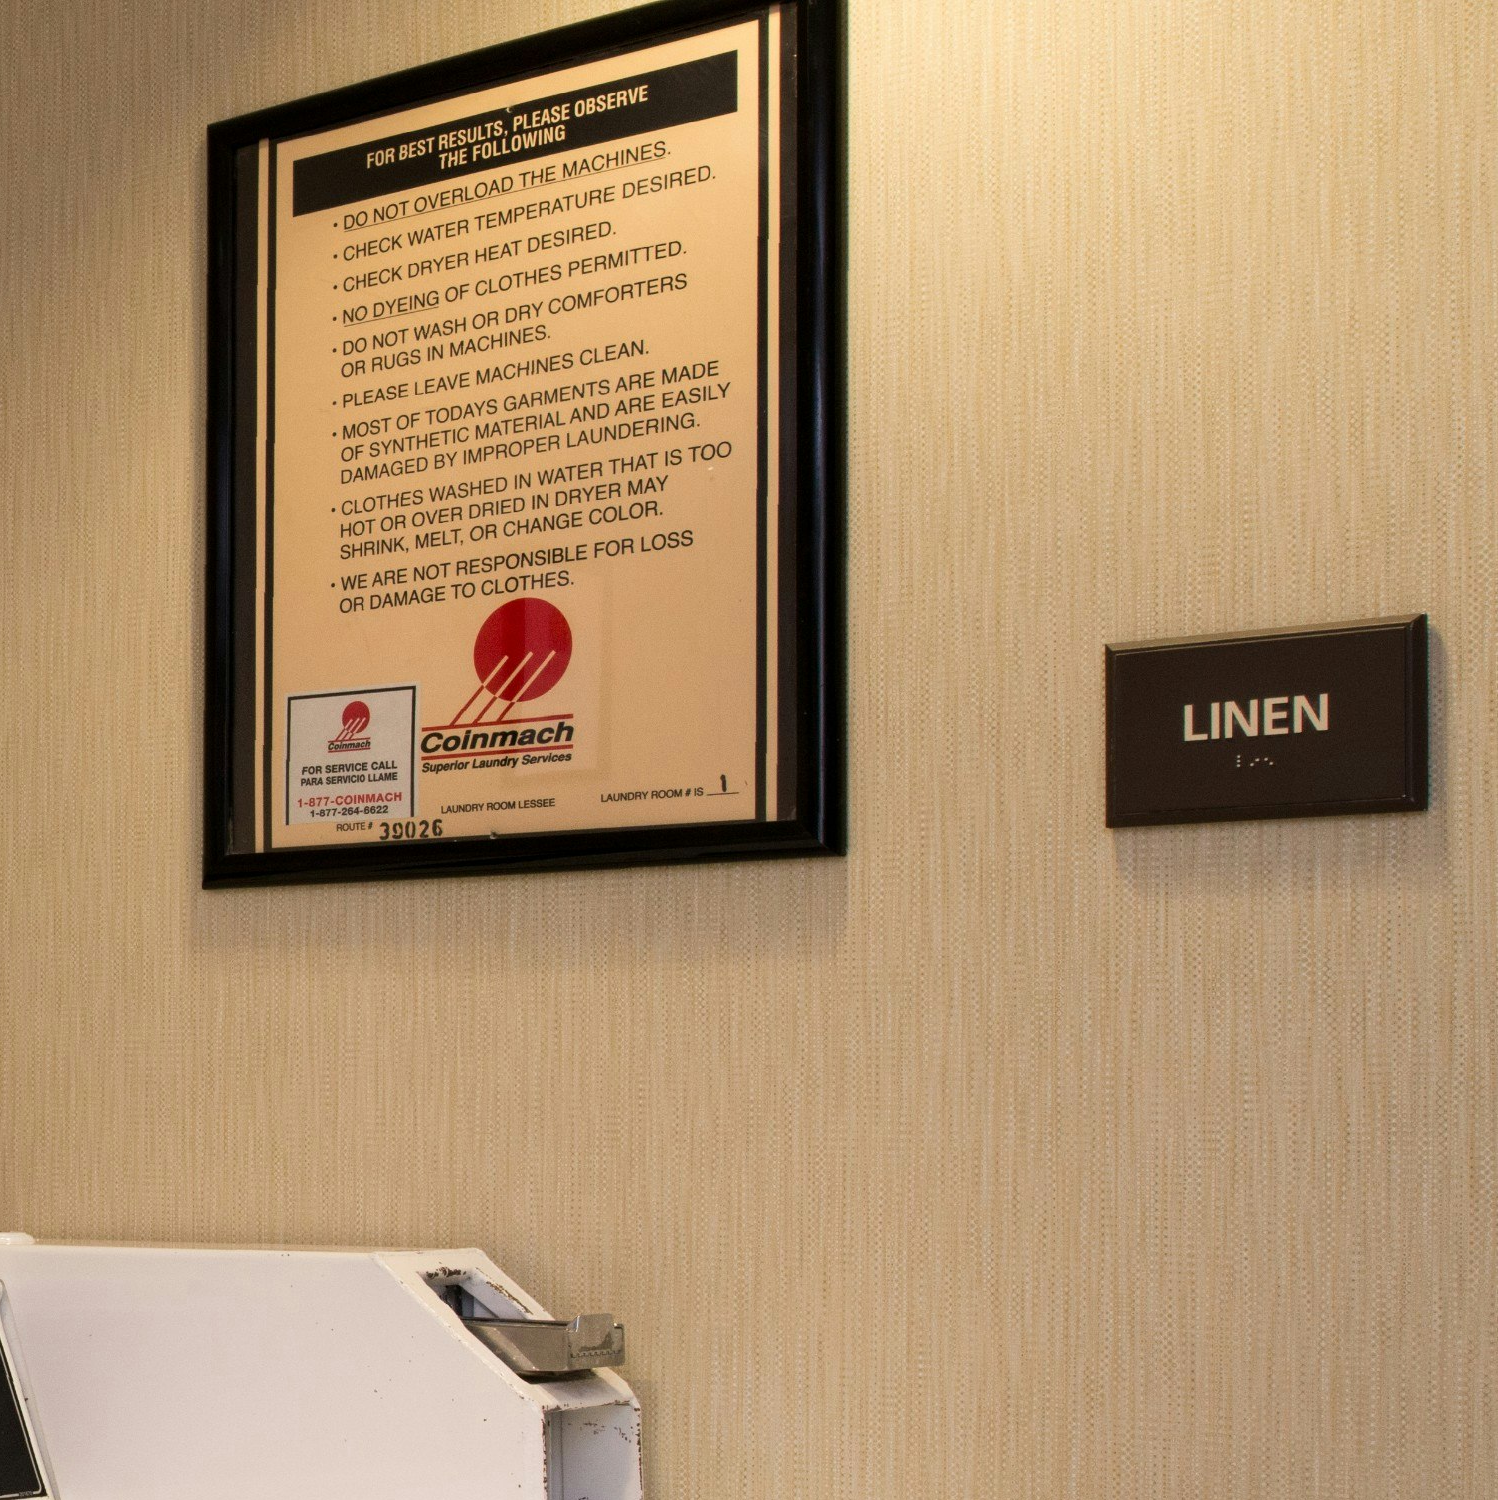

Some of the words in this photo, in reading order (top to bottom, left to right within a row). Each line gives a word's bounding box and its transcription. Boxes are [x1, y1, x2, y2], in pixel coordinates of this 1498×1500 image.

[367, 147, 395, 169] FOR
[398, 136, 435, 161] BEST
[438, 120, 508, 151] RESULTS,
[513, 103, 571, 132] PLEASE
[574, 85, 649, 118] OBSERVE
[438, 147, 468, 170] THE
[472, 125, 566, 162] FOLLOWING
[343, 211, 369, 231] DO
[373, 200, 410, 223] NOT
[413, 175, 514, 213] OVERLOAD
[519, 166, 556, 188] THE
[561, 141, 671, 179] MACHINES.
[342, 233, 403, 262] CHECK
[407, 219, 469, 247] WATER
[473, 185, 616, 231] TEMPERATURE
[622, 165, 716, 199] DESIRED.
[342, 265, 403, 293] CHECK
[407, 251, 469, 279] DRYER
[475, 239, 522, 264] HEAT
[527, 221, 616, 254] DESIRED.
[342, 305, 368, 325] NO
[372, 290, 439, 318] DYEING
[444, 283, 470, 303] OF
[475, 264, 562, 297] CLOTHES
[568, 241, 687, 278] PERMITTED.
[342, 337, 368, 356] DO
[372, 328, 409, 350] NOT
[413, 316, 467, 341] WASH
[472, 310, 499, 330] OR
[505, 301, 544, 324] DRY
[548, 273, 688, 315] COMFORTERS
[341, 359, 366, 378] OR
[371, 348, 422, 373] RUGS
[427, 344, 444, 362] IN
[449, 324, 551, 358] MACHINES.
[342, 383, 409, 409] PLEASE
[414, 371, 470, 396] LEAVE
[476, 352, 574, 386] MACHINES
[579, 340, 649, 366] CLEAN.
[340, 444, 365, 463] OF
[369, 426, 470, 458] SYNTHETIC
[475, 410, 566, 440] MATERIAL
[569, 402, 610, 424] AND
[614, 394, 656, 417] ARE
[662, 381, 731, 409] EASILY
[342, 417, 392, 440] MOST
[396, 411, 421, 431] OF
[424, 398, 498, 425] TODAYS
[503, 379, 611, 412] GARMENTS
[614, 371, 655, 394] ARE
[661, 361, 719, 385] MADE
[341, 456, 429, 485] DAMAGED
[434, 451, 458, 470] BY
[463, 434, 560, 465] IMPROPER
[566, 413, 700, 449] LAUNDERING.
[341, 489, 424, 516] CLOTHES
[428, 476, 508, 503] WASHED
[514, 472, 531, 490] IN
[537, 461, 603, 486] WATER
[608, 452, 659, 475] THAT
[664, 448, 683, 467] IS
[687, 441, 732, 463] TOO
[340, 518, 376, 539] HOT
[380, 514, 407, 532] OR
[411, 506, 463, 528] OVER
[468, 497, 526, 520] DRIED
[532, 493, 549, 511] IN
[555, 482, 621, 507] DRYER
[627, 475, 669, 497] MAY
[340, 536, 409, 560] SHRINK,
[415, 528, 464, 550] MELT,
[469, 523, 497, 542] OR
[503, 510, 583, 537] CHANGE
[588, 500, 663, 525] COLOR.
[340, 573, 368, 591] WE
[371, 567, 408, 588] ARE
[413, 562, 452, 582] NOT
[456, 544, 588, 577] RESPONSIBLE
[594, 538, 635, 559] FOR
[640, 529, 694, 553] LOSS
[339, 596, 364, 614] OR
[369, 585, 446, 610] DAMAGE
[450, 582, 476, 600] TO
[480, 570, 574, 596] CLOTHES.
[420, 721, 574, 754] Coinmach
[1184, 693, 1329, 742] LINEN
[301, 765, 323, 776] FOR
[325, 761, 368, 774] SERVICE
[370, 760, 398, 771] CALL
[327, 740, 371, 751] Coinmach
[421, 759, 471, 774] Superior
[472, 755, 520, 769] Laundry
[521, 752, 572, 766] Services
[297, 791, 402, 808] 1-877-COINMACH
[300, 776, 324, 787] PARA
[325, 773, 366, 786] SERVICIO
[367, 771, 398, 783] LLAME
[441, 802, 485, 815] LAUNDRY
[486, 800, 516, 811] ROOM
[518, 797, 556, 809] LESSEE
[600, 790, 649, 803] LAUNDRY
[651, 788, 683, 800] ROOM
[685, 788, 692, 797] #
[694, 786, 704, 797] IS
[719, 774, 727, 793] 1
[310, 804, 389, 818] 1-877-264-6622
[336, 821, 366, 832] ROUTE
[367, 821, 373, 830] #
